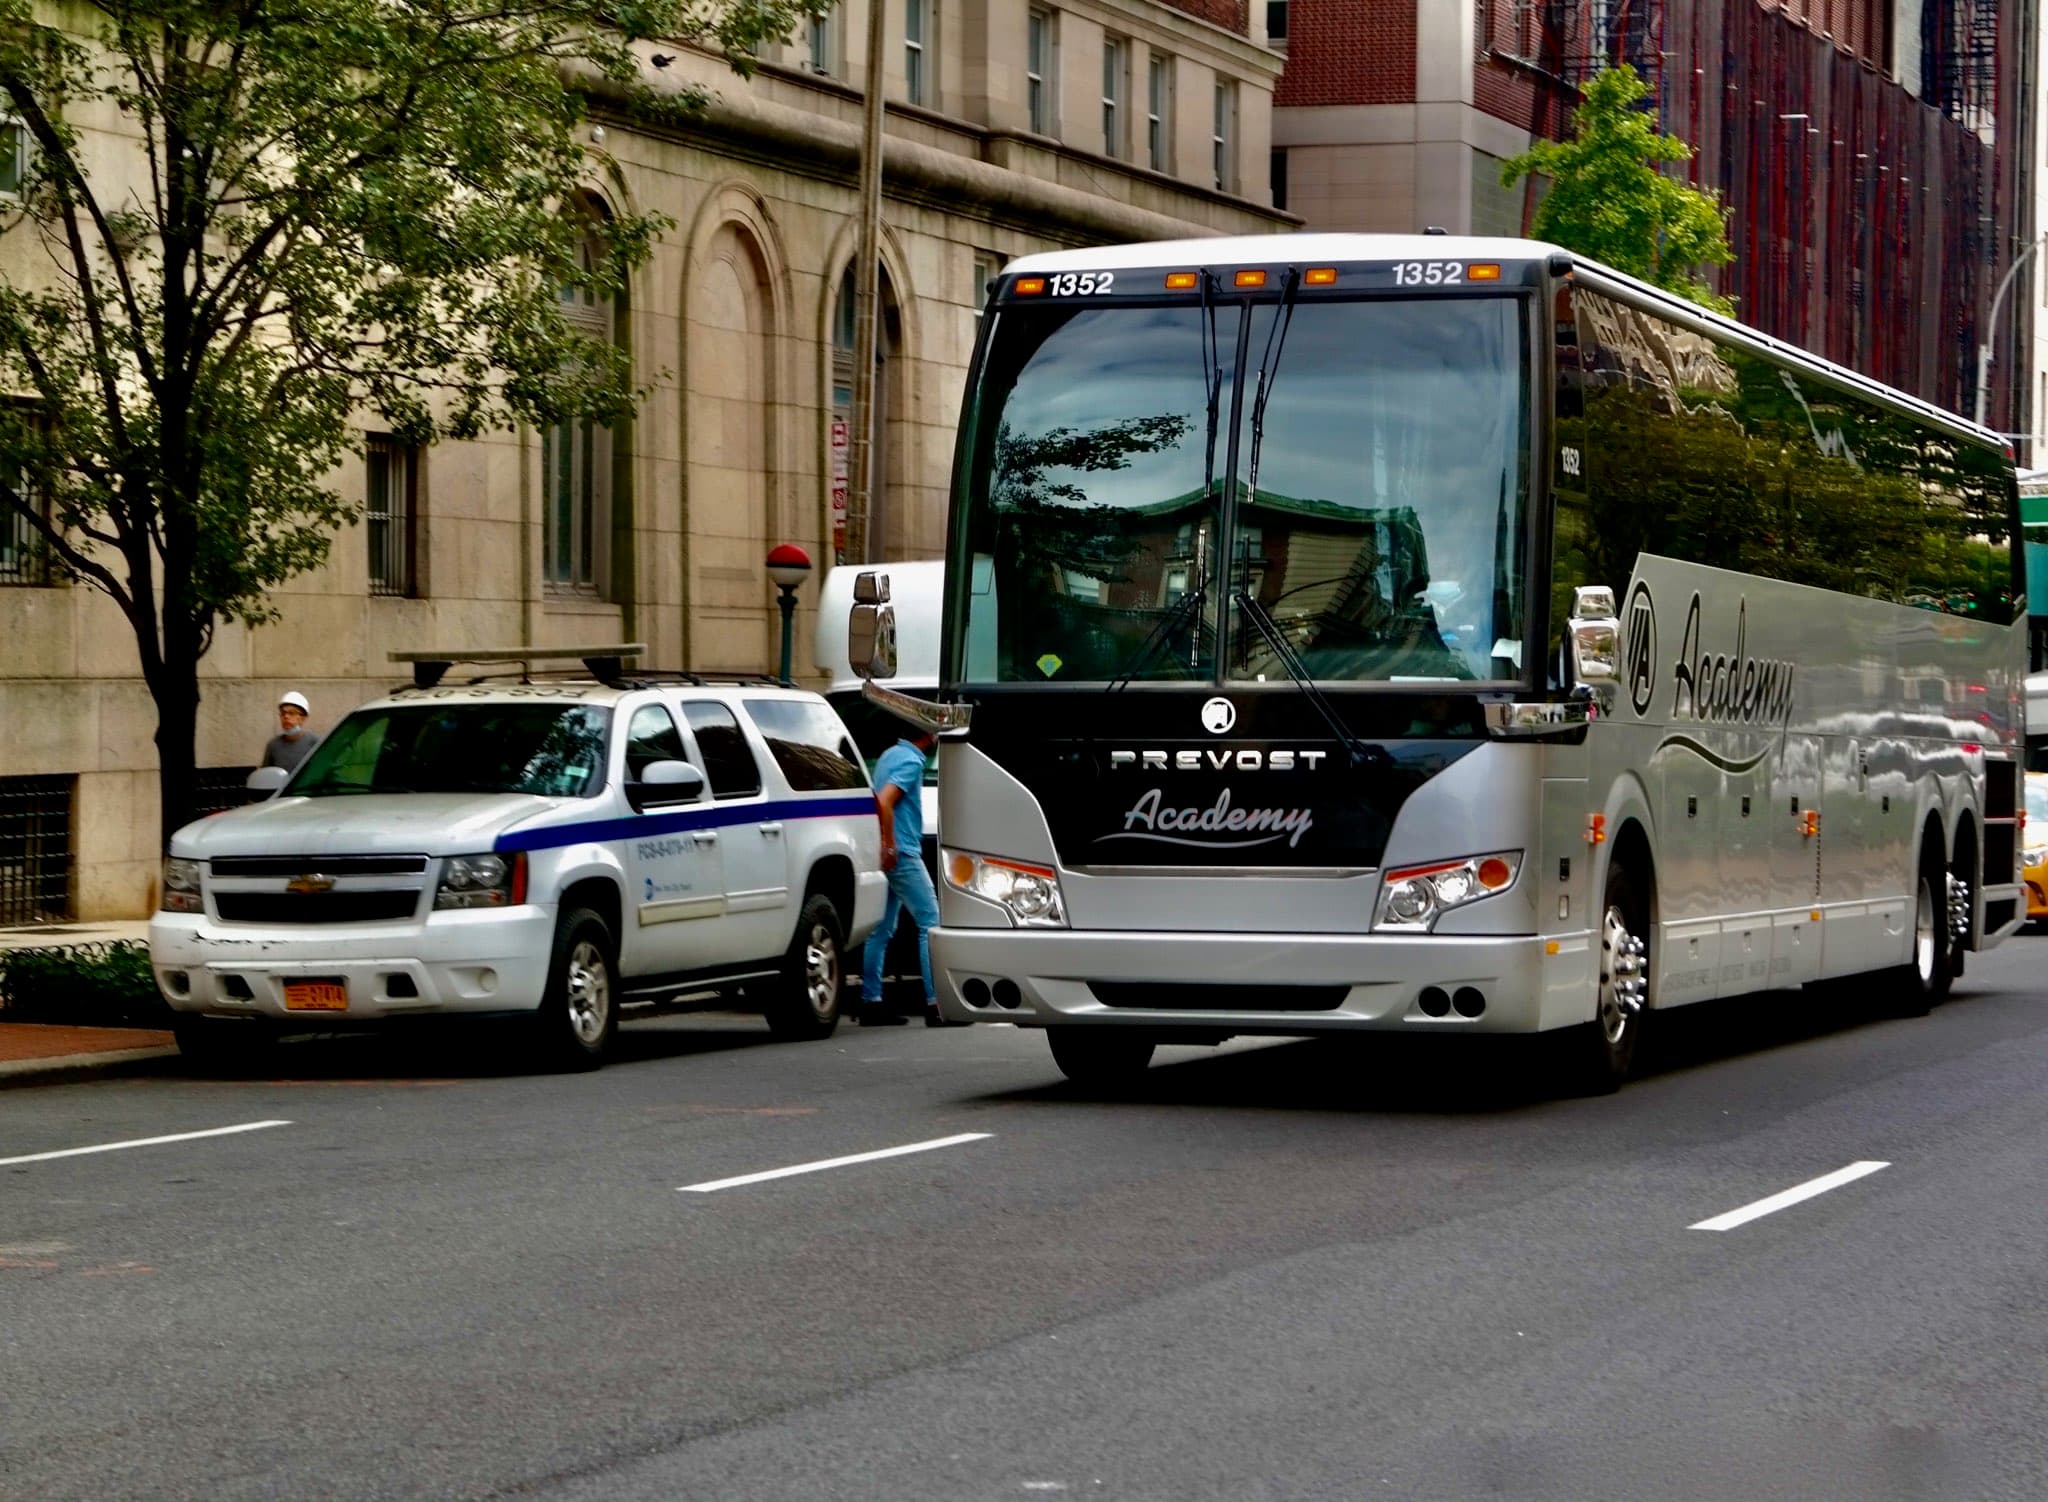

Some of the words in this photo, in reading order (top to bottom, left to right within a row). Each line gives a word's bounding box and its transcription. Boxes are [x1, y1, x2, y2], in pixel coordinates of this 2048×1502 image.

[1049, 272, 1114, 296] 1352
[1392, 262, 1463, 286] 1352
[1561, 446, 1580, 476] 1352
[1672, 589, 1795, 770] Academy
[1111, 750, 1327, 771] PREVOST
[1124, 787, 1313, 849] Academy
